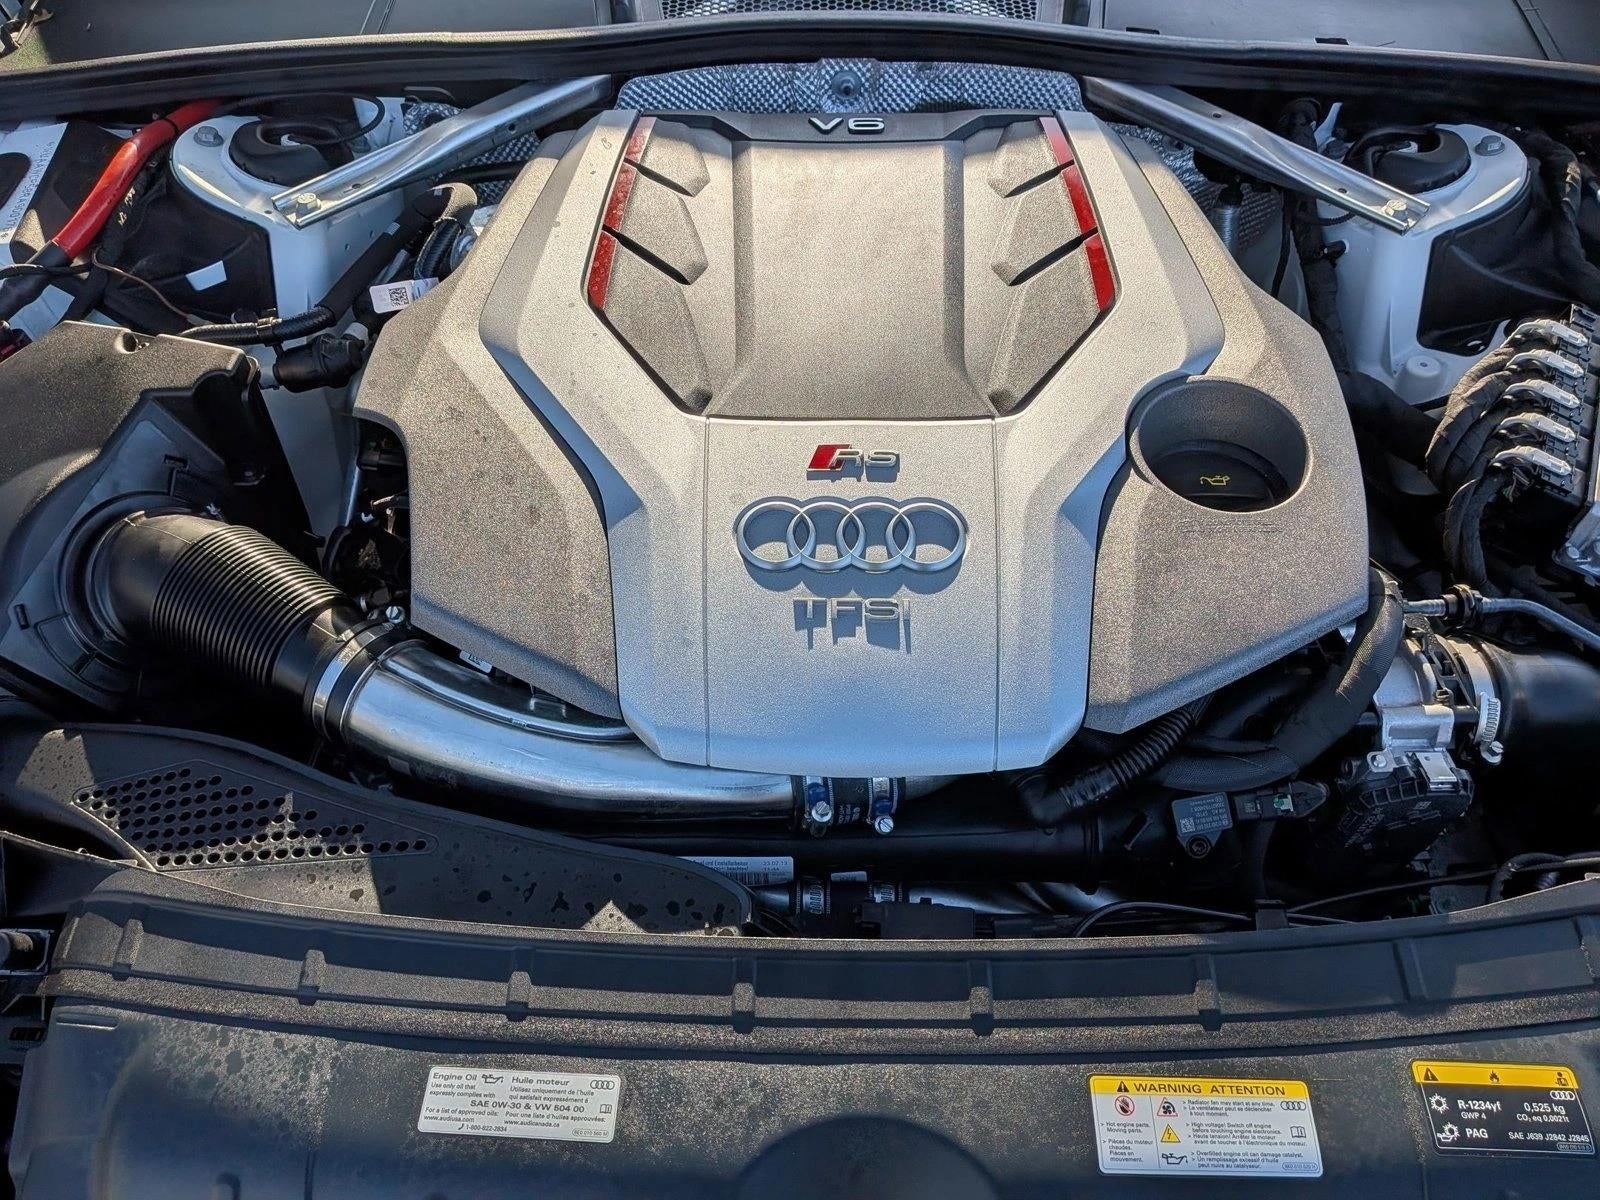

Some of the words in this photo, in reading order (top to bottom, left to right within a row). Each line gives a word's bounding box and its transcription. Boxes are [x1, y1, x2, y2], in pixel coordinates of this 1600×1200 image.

[808, 117, 885, 135] V6
[822, 446, 900, 469] RS
[793, 597, 911, 620] TFSI
[433, 1073, 462, 1081] Engine
[511, 1076, 534, 1084] Huile
[429, 1090, 456, 1098] expressly
[1133, 1082, 1202, 1094] WARNING
[1209, 1085, 1285, 1096] ATTENTION
[470, 1100, 490, 1108] SAE
[491, 1101, 522, 1110] 0W-30
[535, 1103, 552, 1111] VW
[554, 1104, 571, 1112] 504
[1457, 1099, 1502, 1112] R-1234yf
[1523, 1102, 1551, 1113] 0,525
[1552, 1103, 1566, 1115] kg
[1460, 1111, 1480, 1119] GWP
[1481, 1112, 1487, 1120] 4
[1532, 1115, 1543, 1123] eq
[466, 1124, 507, 1132] 1-800-822-2834
[1465, 1128, 1489, 1139] PAG
[1508, 1131, 1525, 1140] SAE
[1526, 1132, 1544, 1141] J639
[1545, 1133, 1567, 1141] J2842
[1567, 1134, 1590, 1142] J2845
